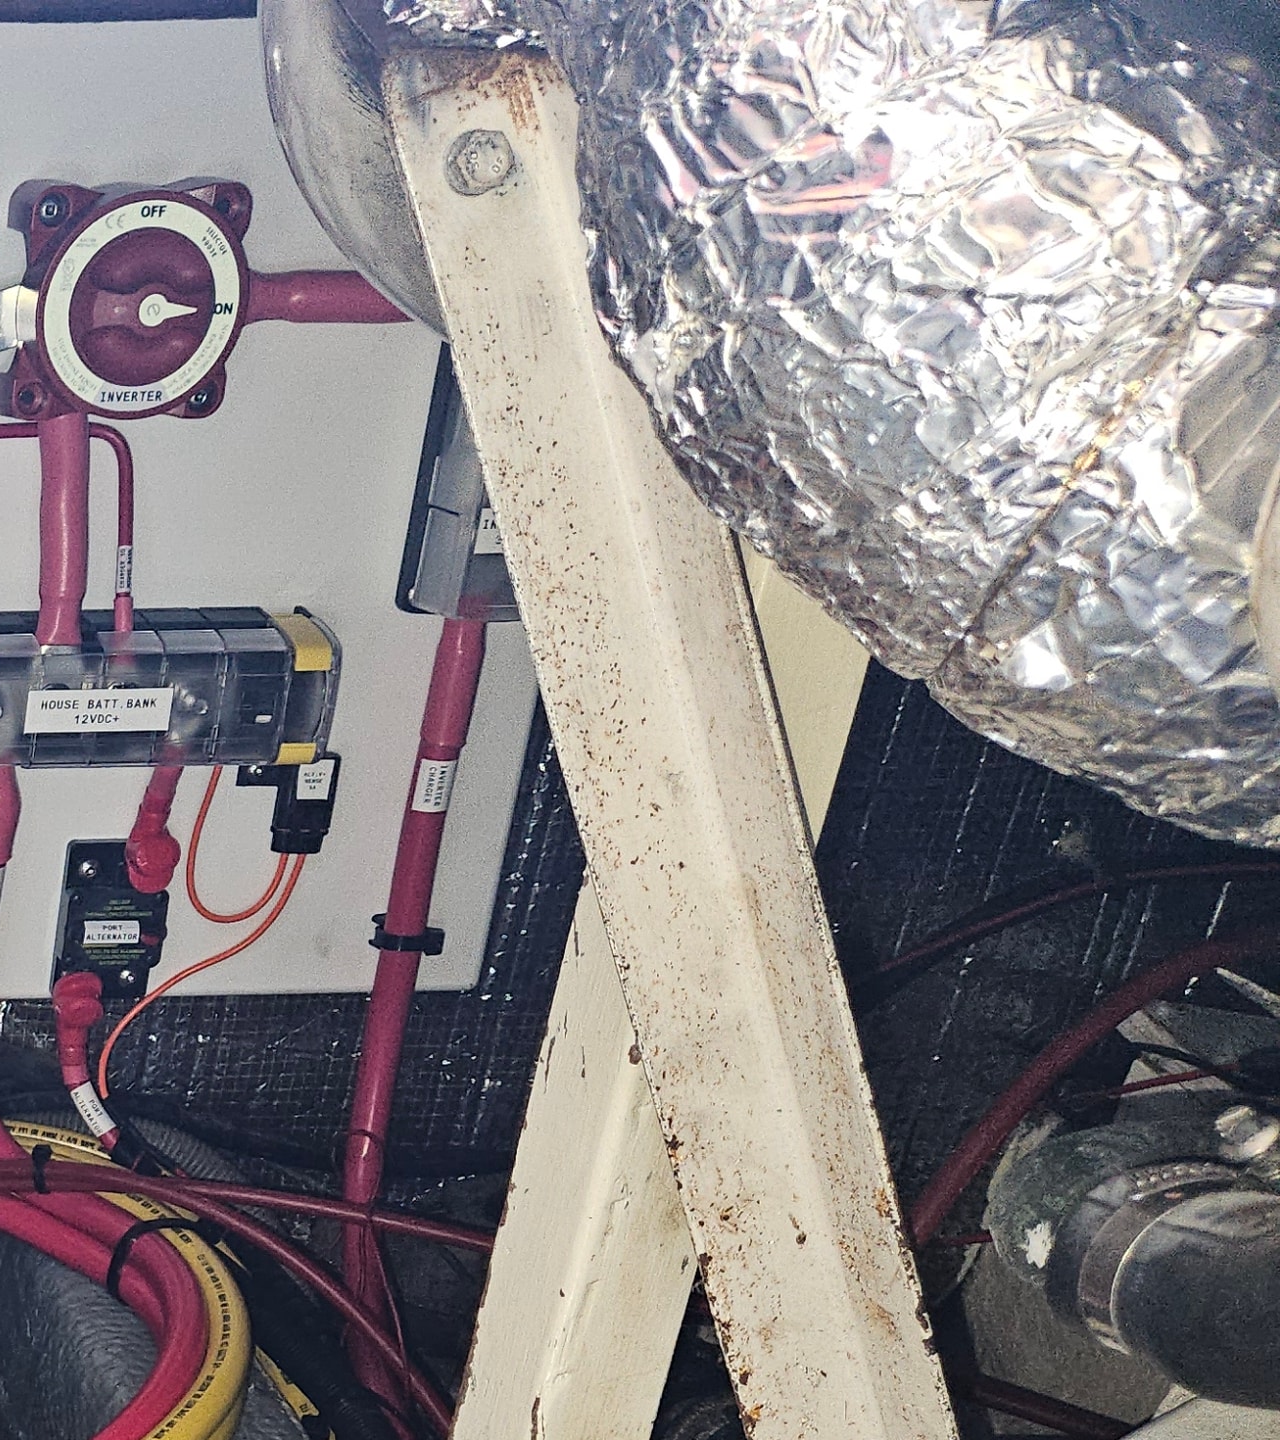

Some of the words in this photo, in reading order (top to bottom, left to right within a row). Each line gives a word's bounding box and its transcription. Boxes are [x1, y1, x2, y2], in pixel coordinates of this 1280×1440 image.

[141, 205, 167, 218] OFF
[205, 226, 228, 255] SELECTOR
[213, 303, 234, 315] ON
[100, 390, 163, 402] INVERTER
[40, 699, 79, 711] HOUSE
[74, 713, 120, 725] 12VDC+
[424, 766, 437, 805] CHARGER
[86, 932, 138, 941] ALTERNATOR
